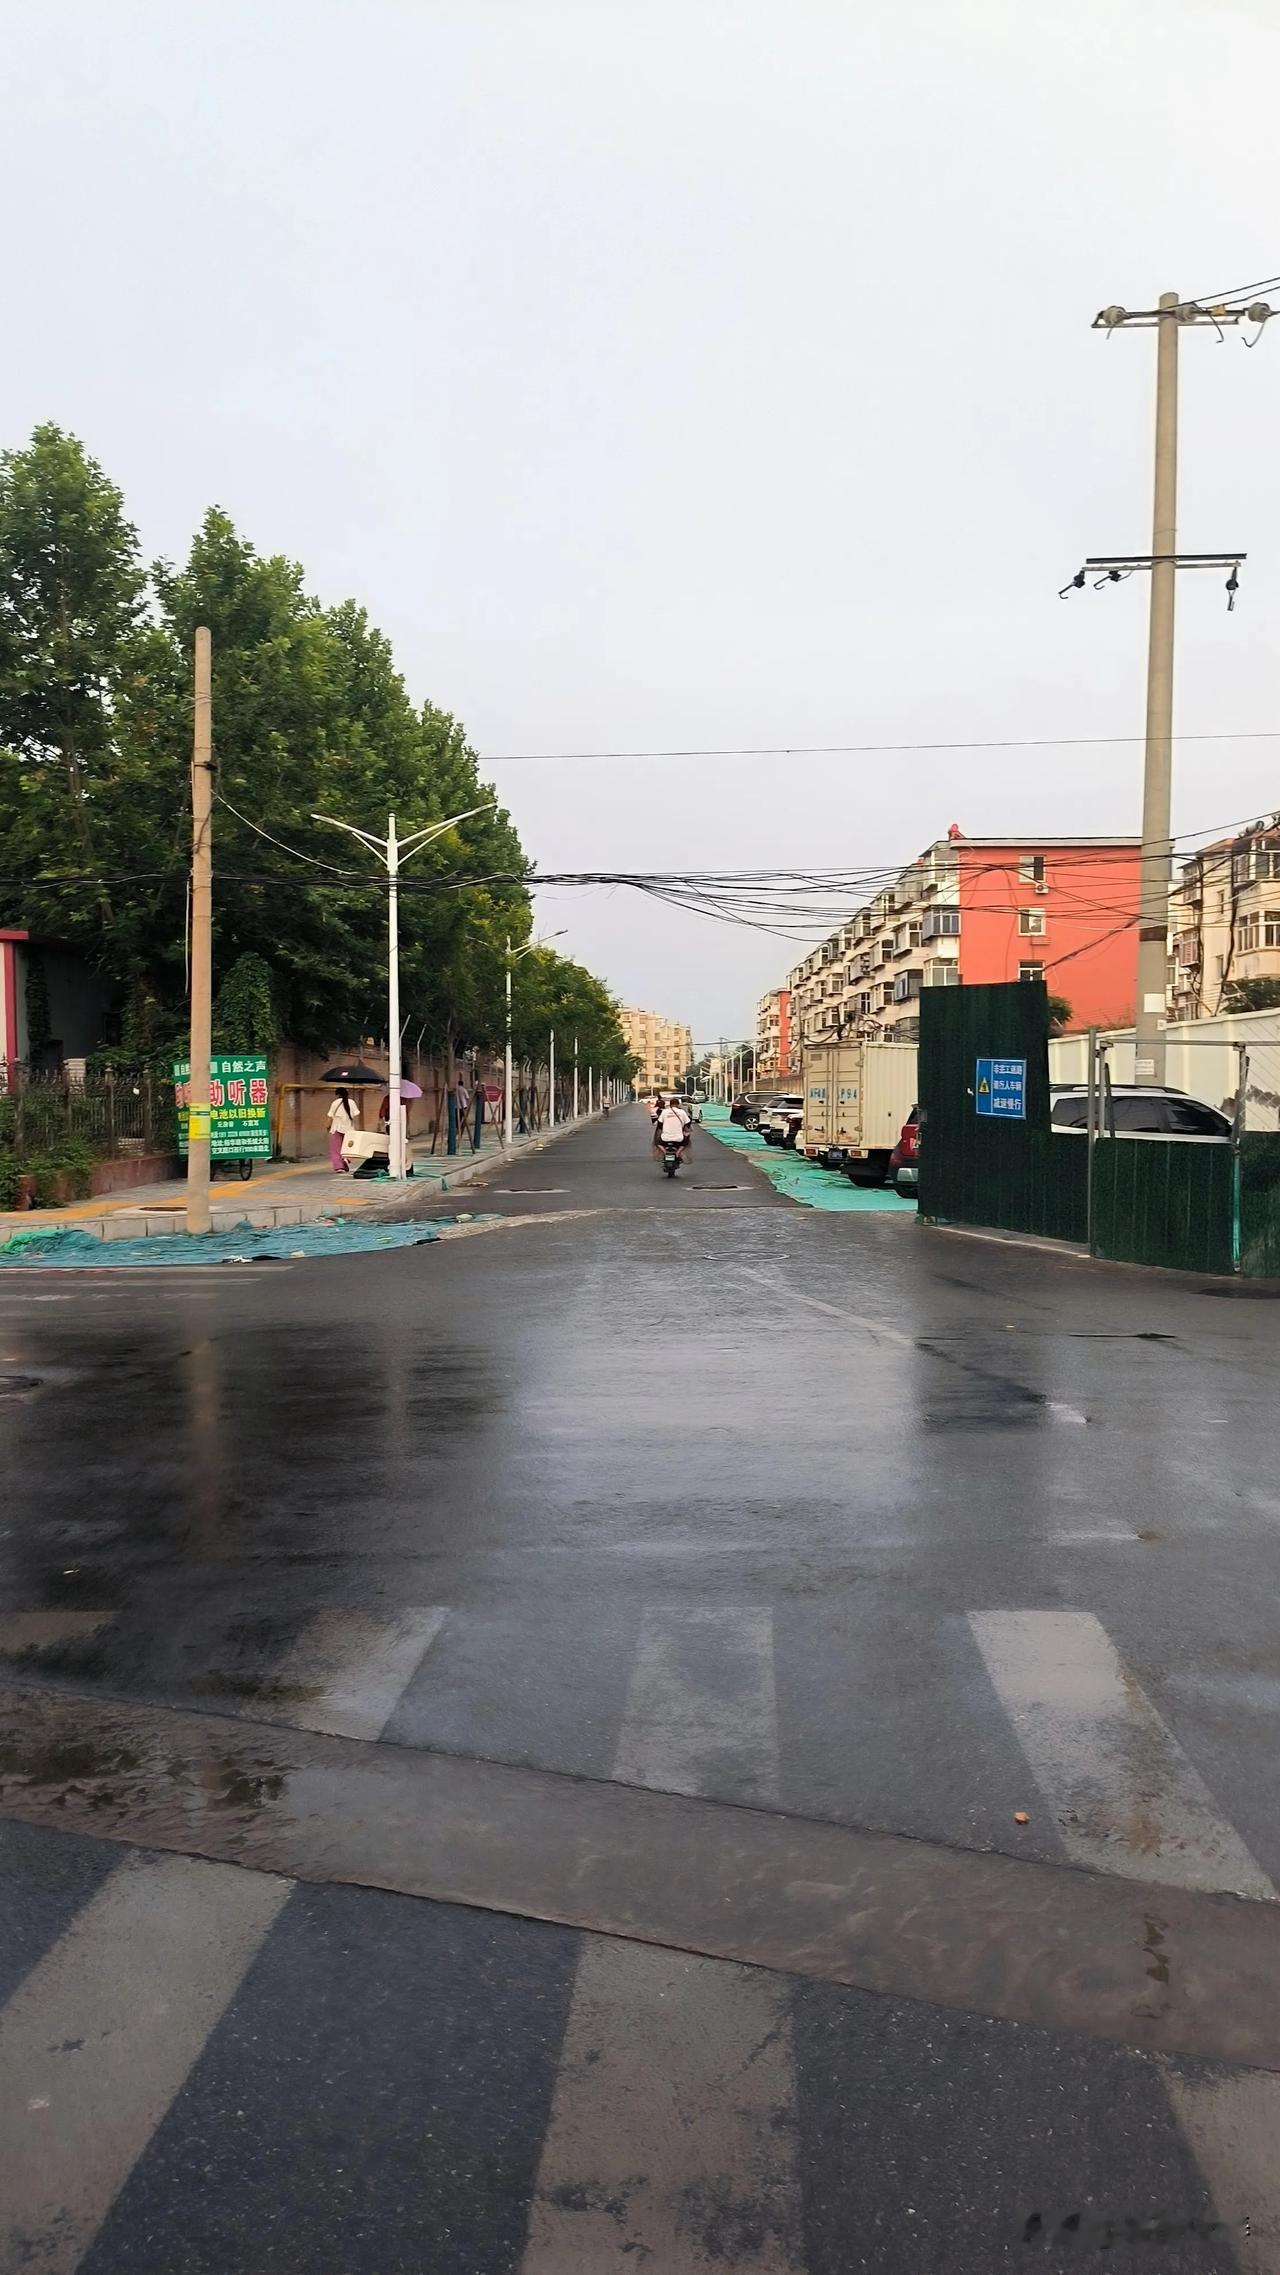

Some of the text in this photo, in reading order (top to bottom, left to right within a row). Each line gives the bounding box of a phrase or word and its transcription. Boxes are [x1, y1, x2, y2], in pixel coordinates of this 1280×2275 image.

[222, 1061, 266, 1073] 自然之声
[209, 1079, 268, 1106] 助听器
[993, 1097, 1022, 1110] 减速慢行
[210, 1107, 266, 1120] 电池以旧换新
